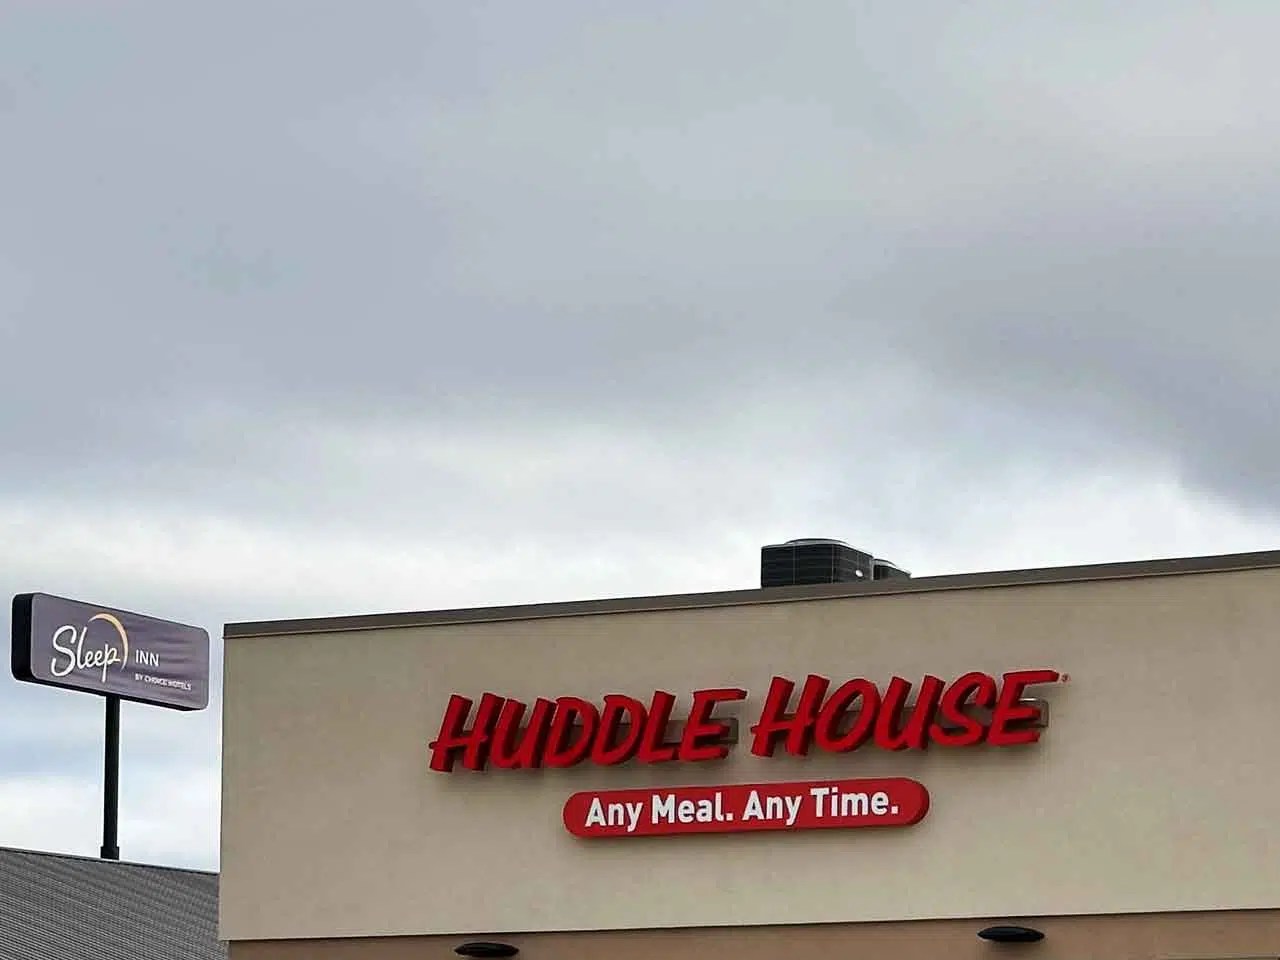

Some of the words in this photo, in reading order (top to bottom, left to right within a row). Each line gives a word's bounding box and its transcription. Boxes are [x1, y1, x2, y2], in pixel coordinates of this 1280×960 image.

[51, 625, 121, 683] Sleep
[135, 649, 159, 667] INN
[429, 688, 747, 772] HUDDLE
[750, 670, 1060, 757] HOUSE
[585, 797, 643, 832] Any
[651, 792, 734, 825] Meal.
[742, 790, 802, 826] Any
[810, 786, 899, 818] Time.
